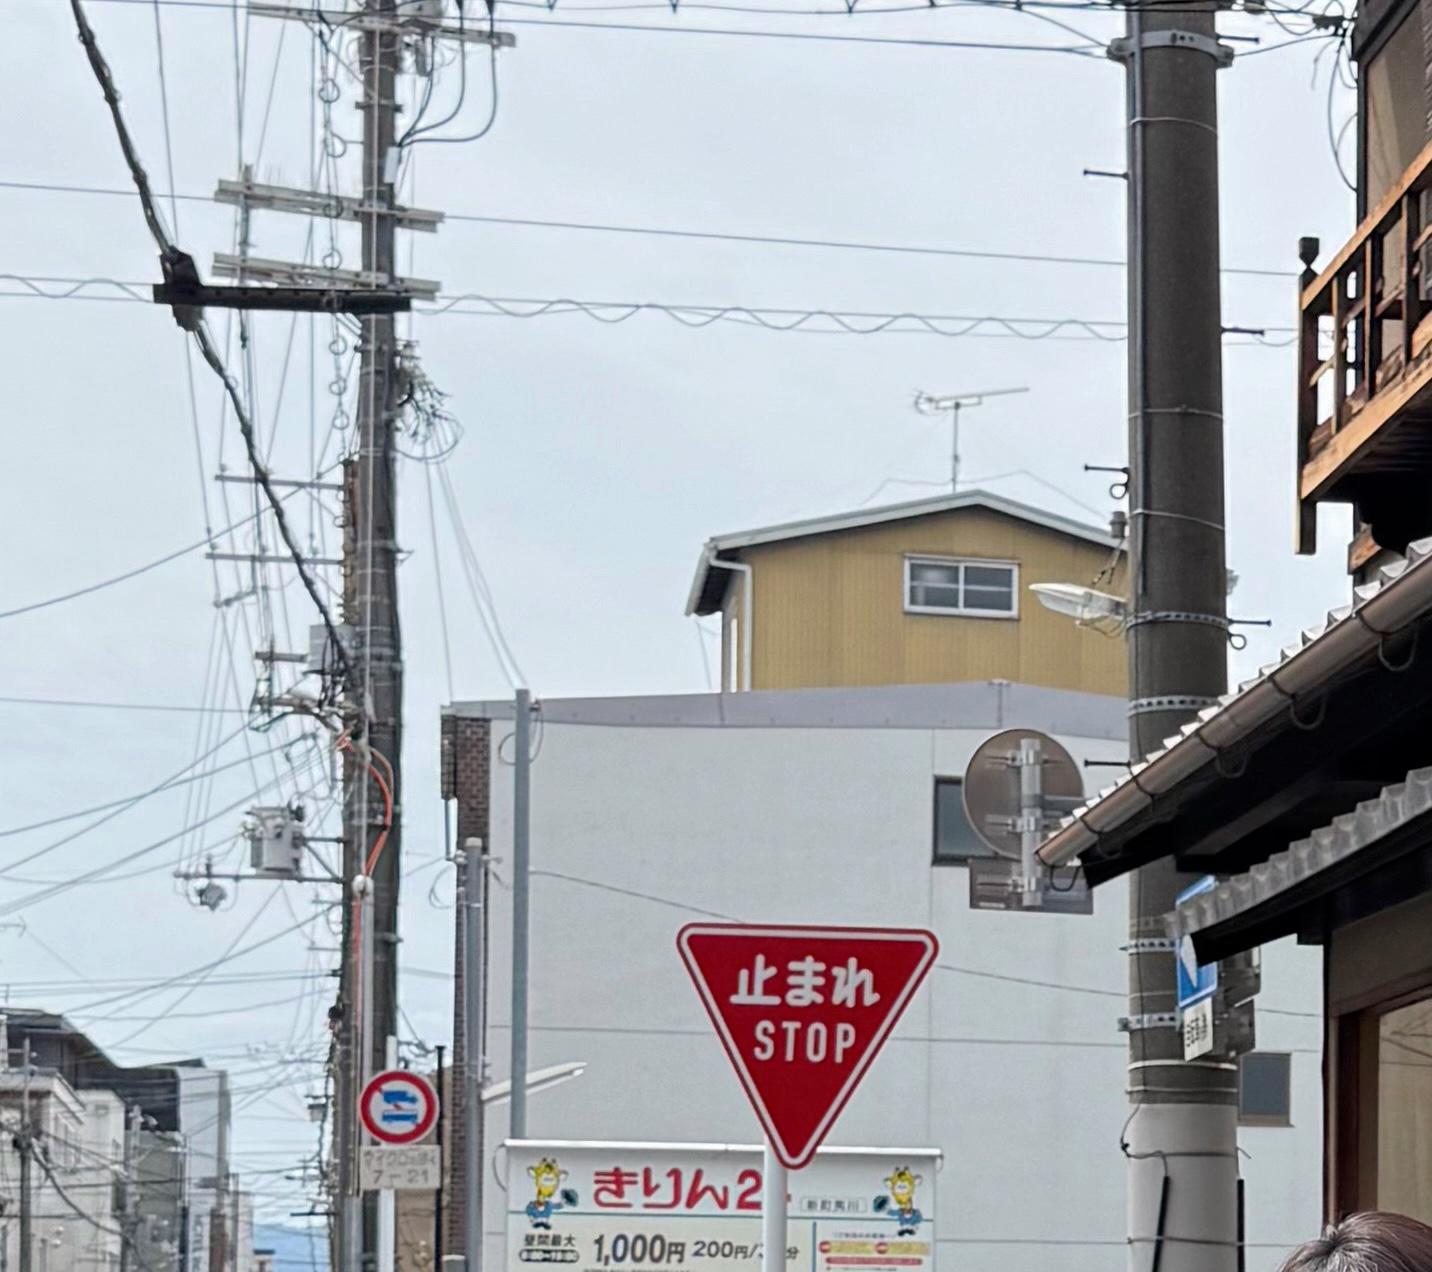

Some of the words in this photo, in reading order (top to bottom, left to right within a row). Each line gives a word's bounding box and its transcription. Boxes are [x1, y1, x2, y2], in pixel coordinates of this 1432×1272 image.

[729, 953, 881, 1008] 止まれ
[754, 1020, 856, 1063] STOP
[593, 1166, 791, 1210] きりん2
[593, 1234, 686, 1266] 1,000円
